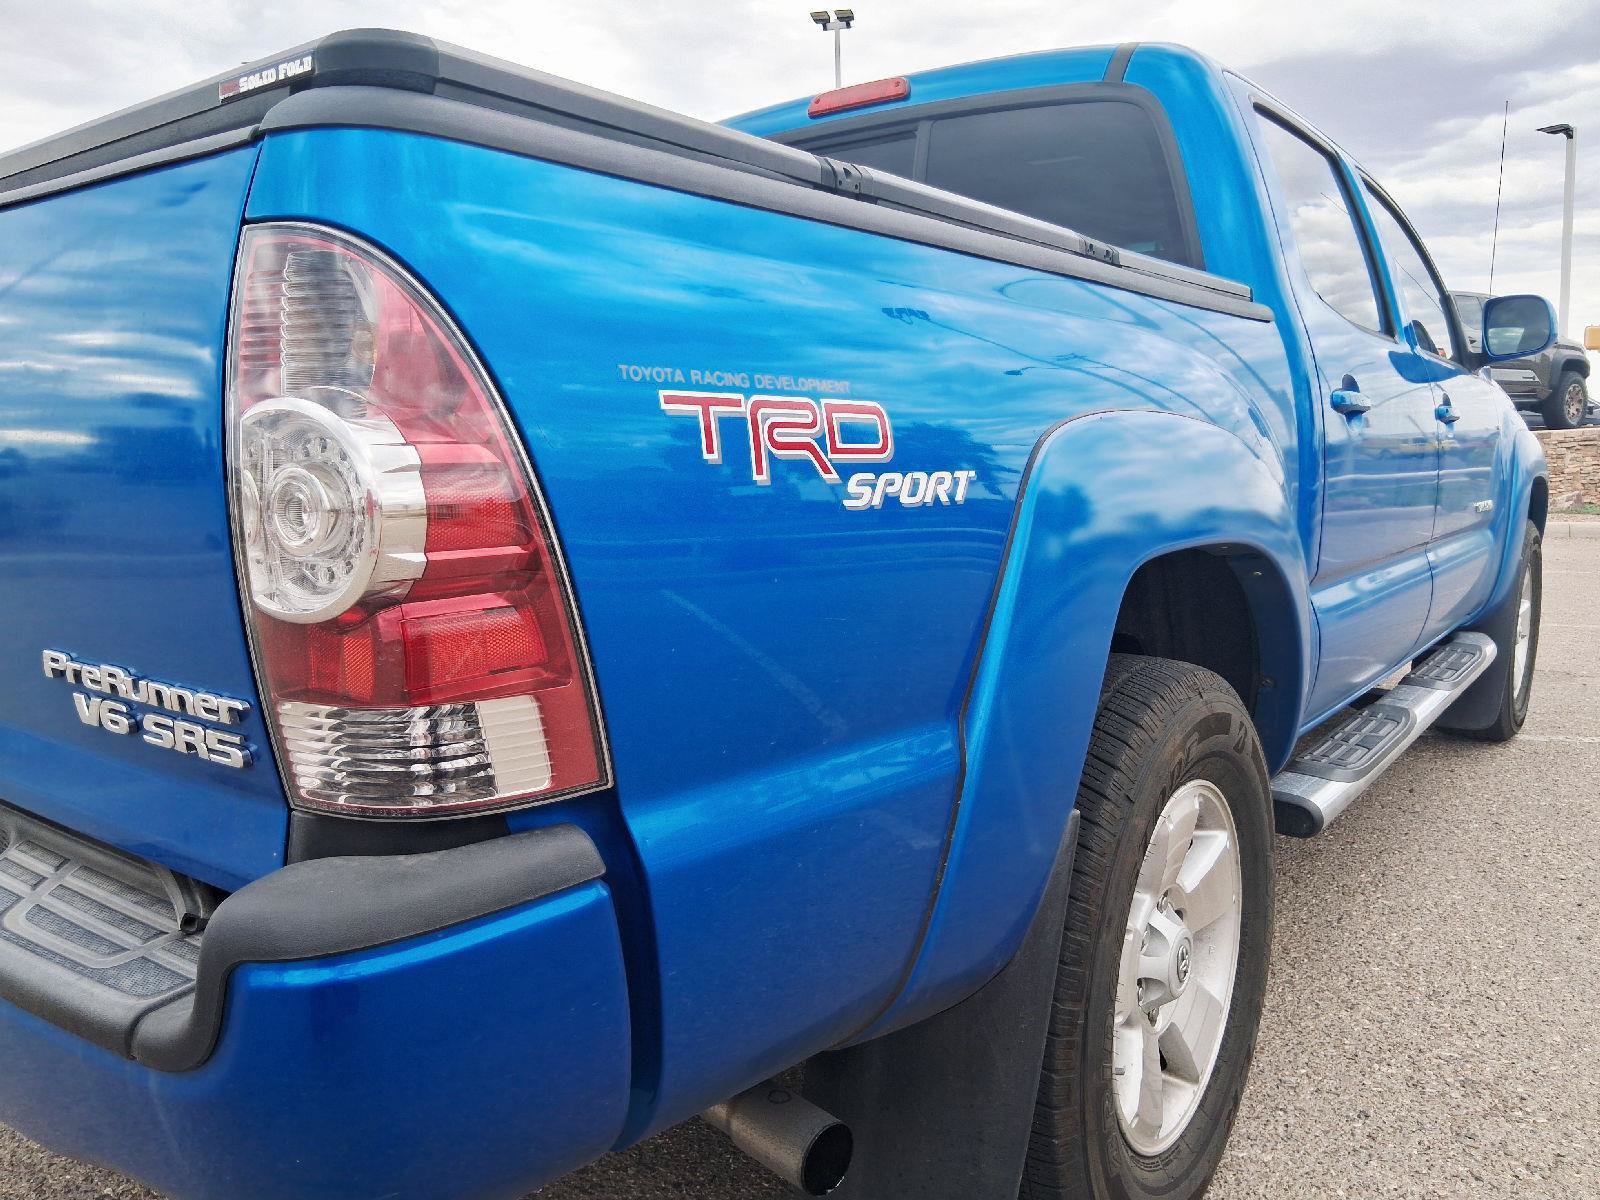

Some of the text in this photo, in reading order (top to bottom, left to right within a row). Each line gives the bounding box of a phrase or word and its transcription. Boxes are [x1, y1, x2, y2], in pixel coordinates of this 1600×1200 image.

[618, 364, 851, 394] TOYOTA RACING DEVELOPMENT
[658, 389, 895, 486] TRD
[842, 470, 976, 511] SPORT
[43, 649, 251, 725] PreRunner
[72, 692, 253, 769] V6 SR5
